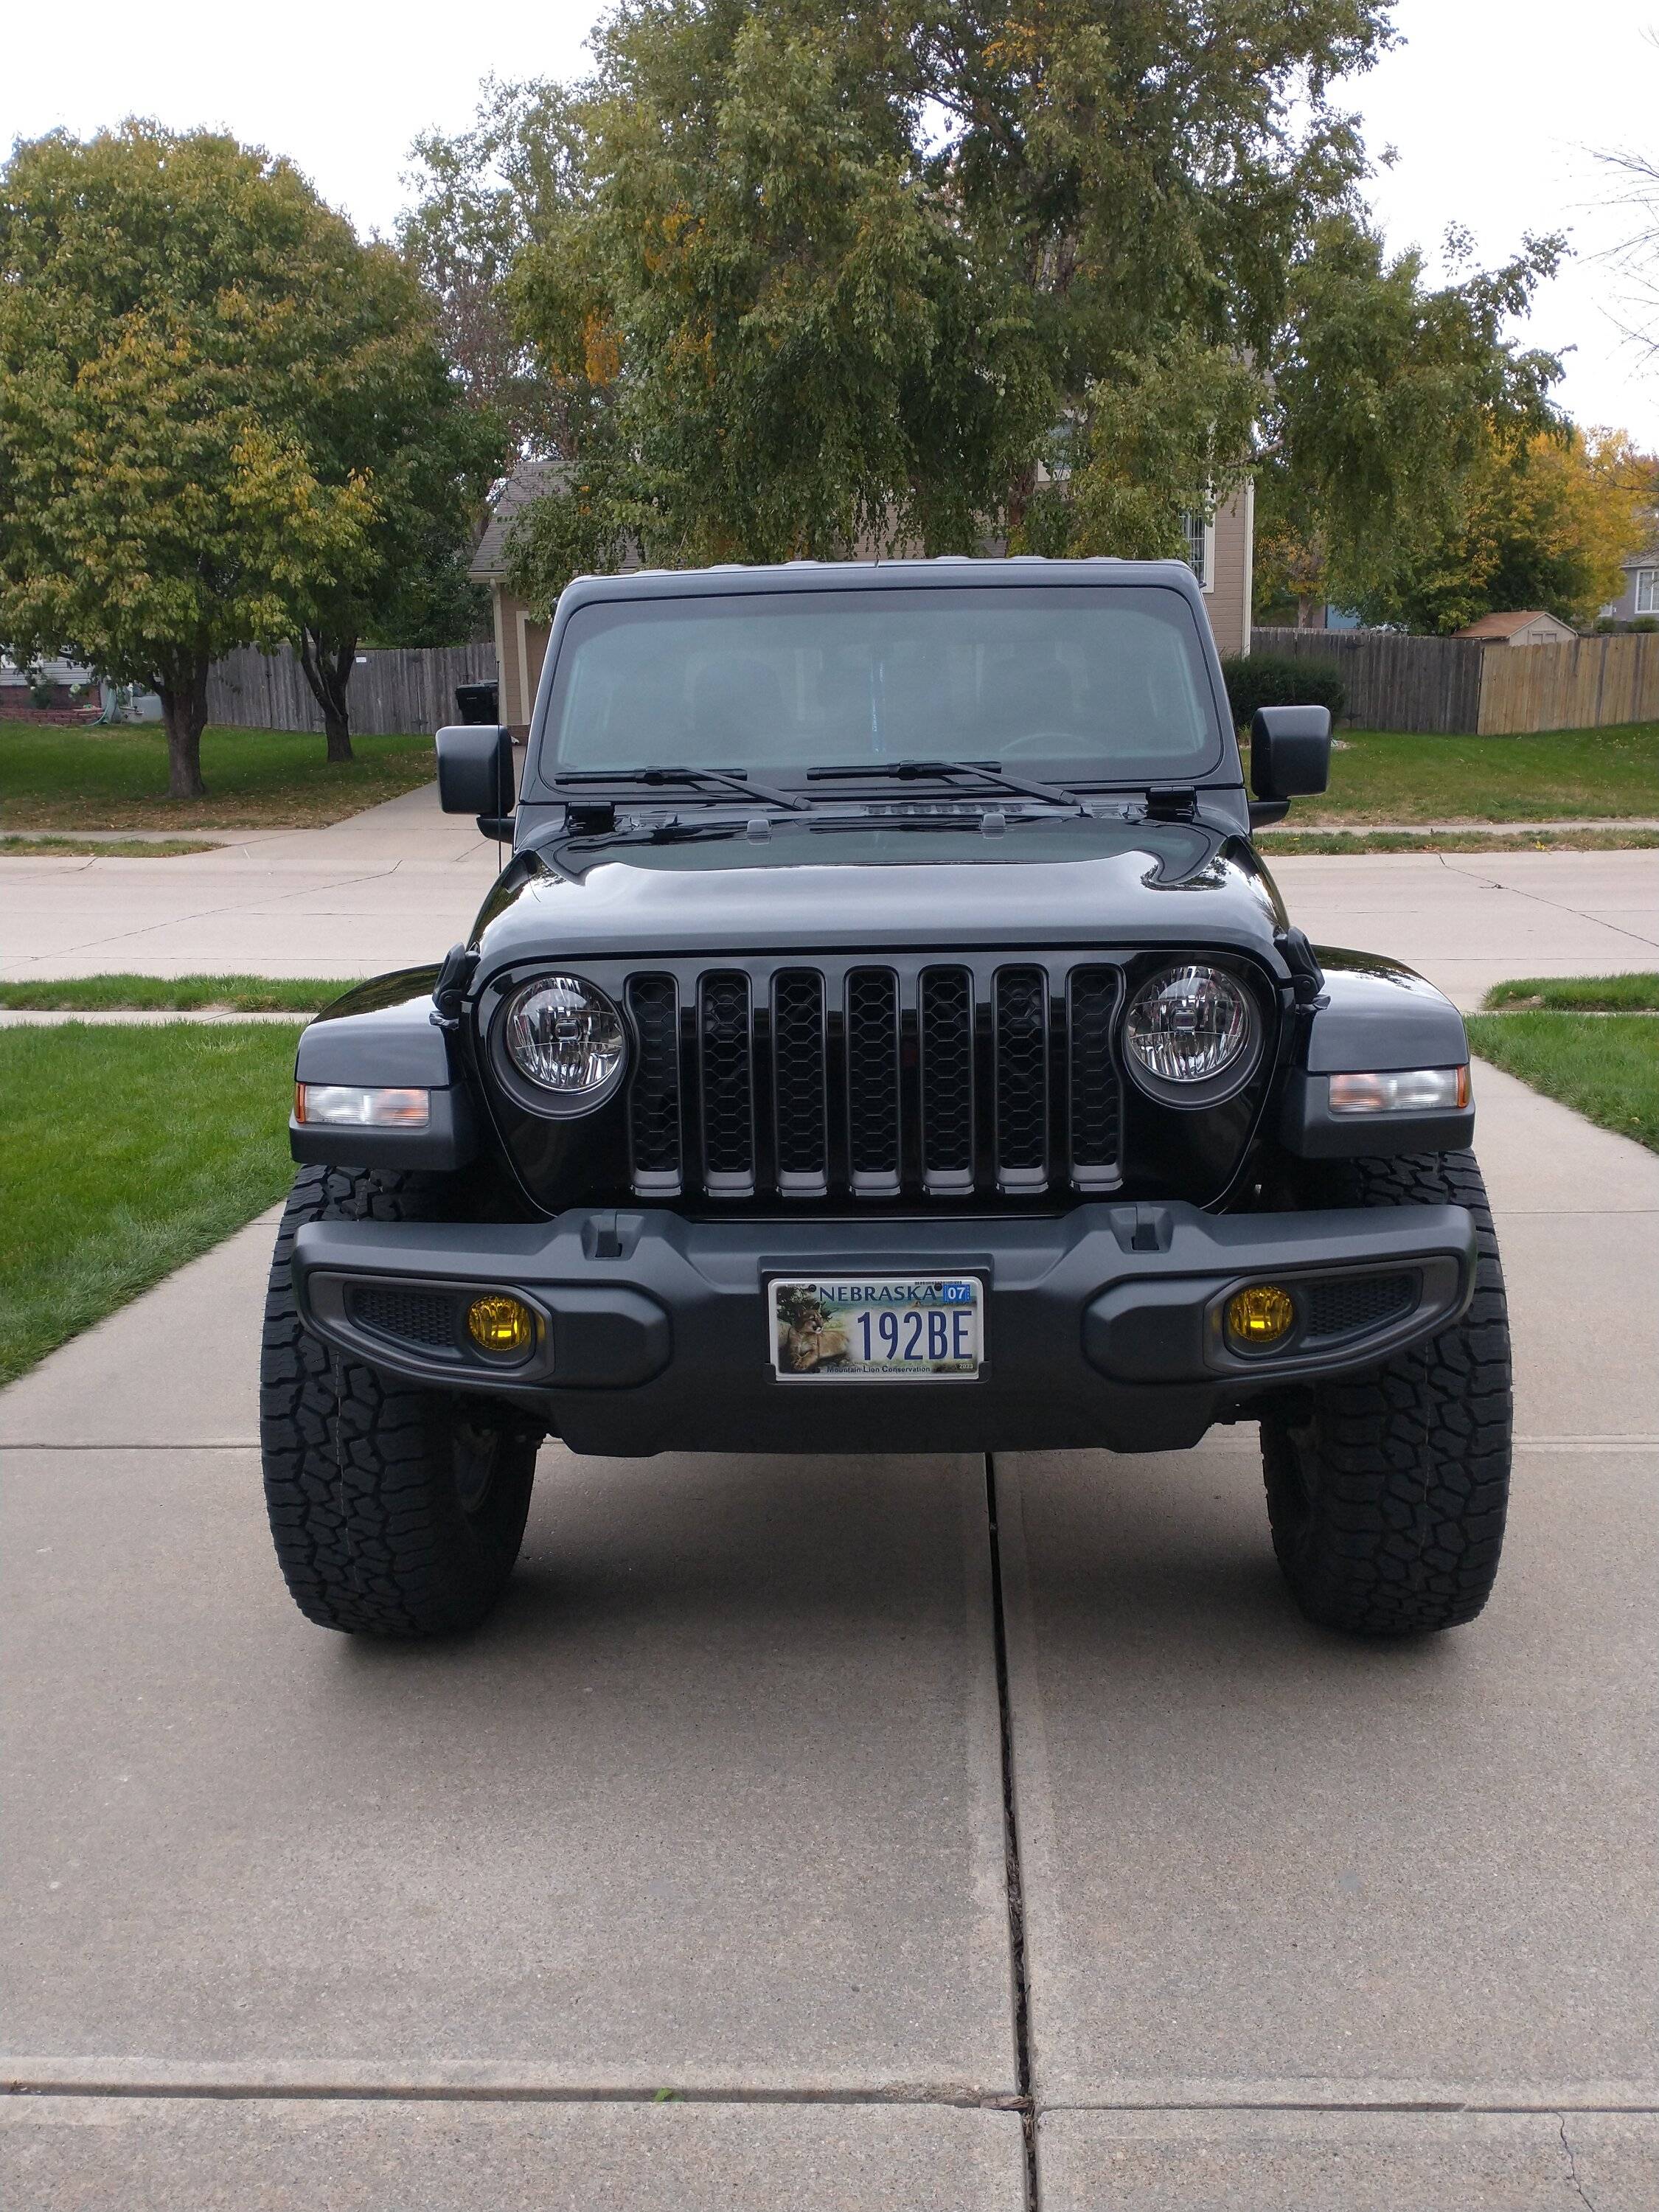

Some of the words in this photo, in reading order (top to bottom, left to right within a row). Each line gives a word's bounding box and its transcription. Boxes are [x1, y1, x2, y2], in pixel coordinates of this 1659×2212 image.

[819, 1285, 937, 1301] NEBRASKA
[947, 1287, 966, 1299] 07
[857, 1310, 973, 1361] 192BE
[827, 1366, 861, 1374] Mountain
[863, 1365, 880, 1373] Lion
[882, 1364, 931, 1374] Conservation
